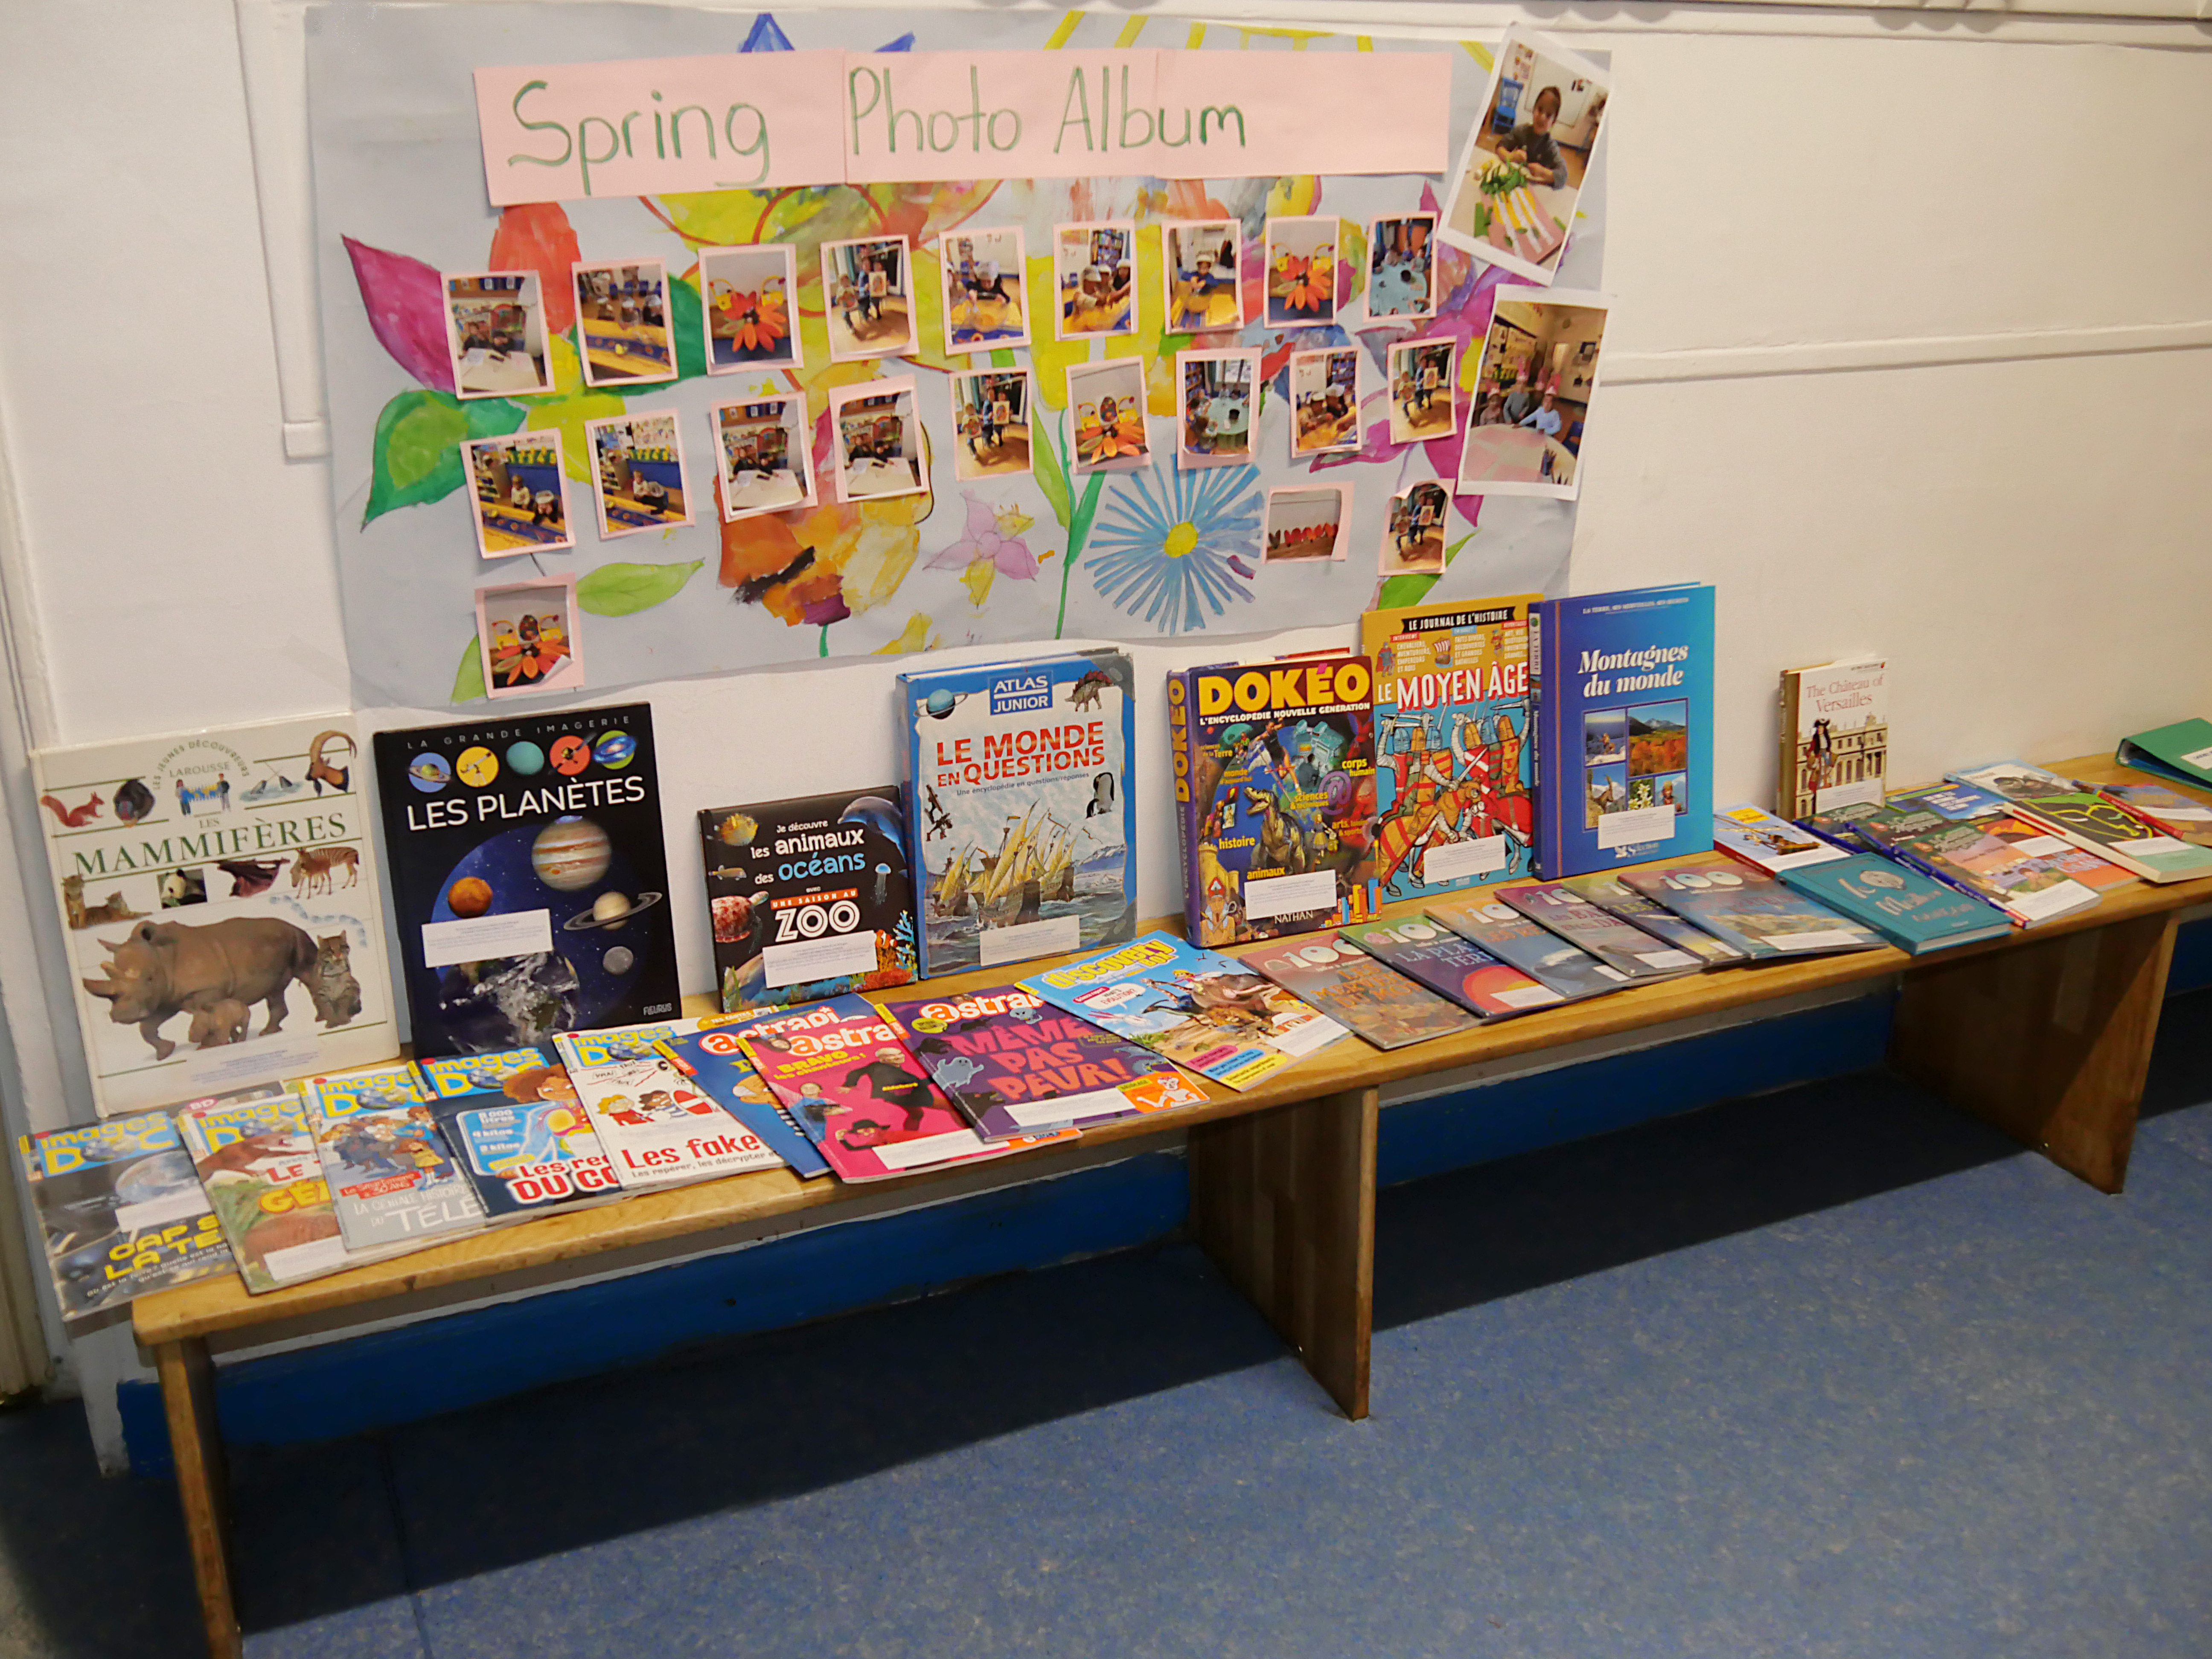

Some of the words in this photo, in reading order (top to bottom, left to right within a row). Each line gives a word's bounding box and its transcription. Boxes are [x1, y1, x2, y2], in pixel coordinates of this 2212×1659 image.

[508, 79, 771, 197] Spring
[849, 65, 1022, 155] Photo
[1053, 65, 1248, 155] Album
[1409, 620, 1417, 631] LE
[1420, 616, 1455, 629] JOURNAL
[1456, 614, 1466, 625] DE
[1578, 644, 1689, 675] Montagnes
[993, 675, 1048, 694] ATLAS
[1198, 663, 1370, 716] DOKÉO
[1378, 682, 1392, 702] LE
[1397, 668, 1481, 710] MOYEN
[1487, 661, 1528, 697] ÂGE
[1583, 674, 1611, 698] du
[1615, 664, 1684, 694] monde
[1807, 684, 1825, 698] The
[1873, 673, 1885, 686] of
[993, 695, 1049, 713] JUNIOR
[1273, 707, 1316, 719] NOUVELLE
[1319, 702, 1371, 714] GÉNÉRATION
[1816, 692, 1872, 712] Versailles
[407, 740, 428, 749] LA
[444, 729, 521, 745] GRANDE
[537, 716, 630, 734] IMAGERIE
[936, 738, 972, 765] LE
[984, 721, 1104, 760] MONDE
[169, 762, 230, 777] LAROUSSE
[937, 771, 960, 786] EN
[963, 746, 1105, 786] QUESTIONS
[1342, 759, 1367, 770] corps
[1349, 766, 1376, 777] humain
[972, 782, 1014, 795] encyclopédie
[1295, 792, 1328, 802] sciences
[407, 798, 469, 831] LES
[477, 776, 646, 821] PLANÈTES
[199, 818, 220, 828] LES
[777, 824, 786, 832] Je
[788, 819, 828, 832] découvre
[73, 812, 347, 876] MAMMIFÈRES
[751, 846, 770, 859] les
[775, 829, 864, 855] animaux
[1218, 835, 1255, 850] histoire
[754, 873, 774, 885] des
[778, 851, 866, 880] océans
[1247, 867, 1286, 880] animaux
[1660, 871, 1743, 890] 100
[773, 900, 787, 908] UNE
[798, 893, 837, 905] SAISON
[1536, 888, 1585, 905] 10
[775, 900, 860, 942] ZOO
[1274, 911, 1313, 924] NATHAN
[1466, 903, 1519, 923] 10
[1283, 938, 1366, 968] 100
[1395, 950, 1431, 962] LA
[1425, 943, 1475, 957] PLA
[1441, 952, 1494, 967] TER
[1046, 940, 1175, 988] discovery
[1339, 963, 1382, 980] LES
[1369, 981, 1424, 1001] MON
[568, 1027, 672, 1046] images
[788, 1024, 897, 1056] astra
[421, 1047, 540, 1074] images
[777, 1051, 848, 1073] BRAVO
[990, 1042, 1085, 1074] PAS
[314, 1072, 413, 1093] image
[192, 1100, 301, 1128] image
[34, 1111, 166, 1149] images
[621, 1147, 680, 1169] Les
[686, 1135, 760, 1158] fake
[716, 1153, 765, 1165] décrypter
[267, 1164, 303, 1182] LE
[520, 1162, 566, 1178] Les
[512, 1175, 568, 1200] DU
[105, 1252, 161, 1280] LA
[166, 1230, 221, 1255] TE
